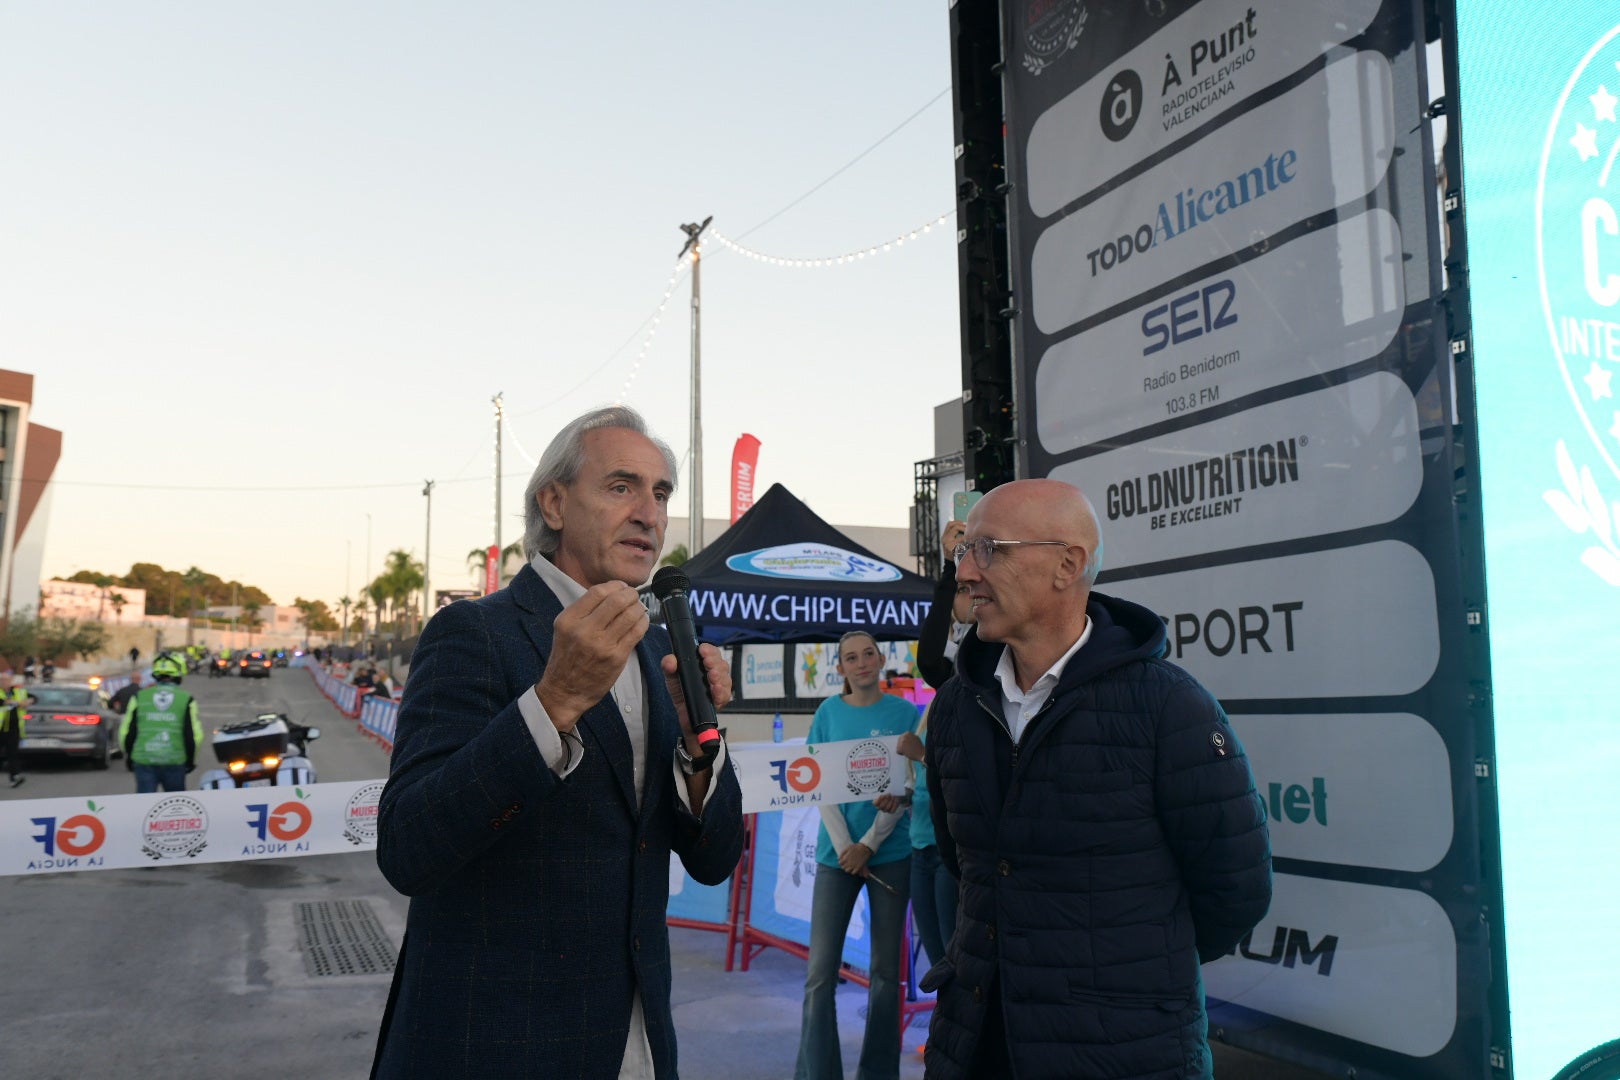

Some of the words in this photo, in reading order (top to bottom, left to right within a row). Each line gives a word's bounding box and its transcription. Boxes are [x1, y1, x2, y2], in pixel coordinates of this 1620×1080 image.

[1162, 53, 1182, 96] À
[1191, 8, 1257, 77] Punt
[1162, 44, 1256, 116] RADIOTELEVISIÓ
[1162, 81, 1236, 132] VALENCIANA
[1086, 149, 1298, 277] TODOAlicante
[1142, 279, 1239, 356] SER
[1143, 364, 1176, 393] Radio
[1181, 350, 1240, 382] Benidorm
[1165, 391, 1197, 415] 103.8
[1200, 385, 1220, 406] FM
[1150, 514, 1166, 531] BE
[1171, 500, 1242, 527] EXCELLENT
[1259, 777, 1328, 827] ret
[1226, 926, 1339, 976] UM
